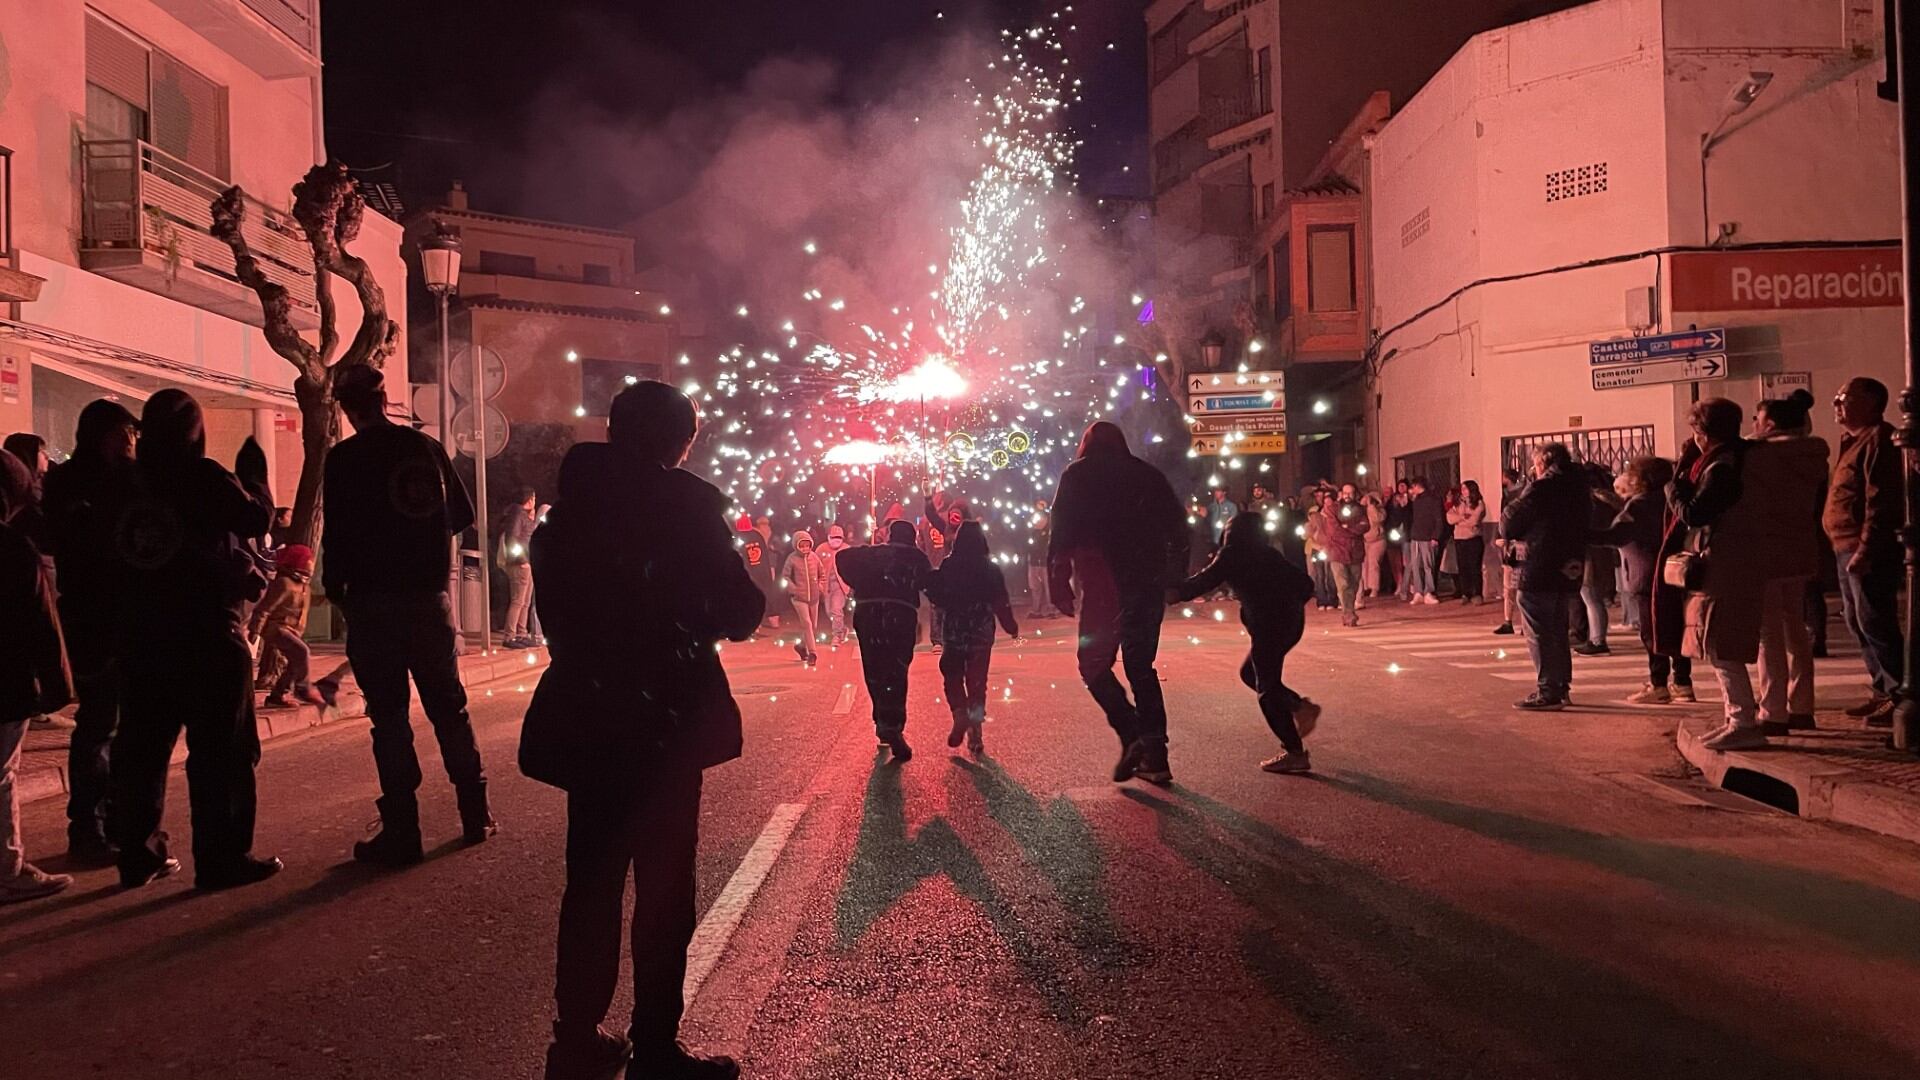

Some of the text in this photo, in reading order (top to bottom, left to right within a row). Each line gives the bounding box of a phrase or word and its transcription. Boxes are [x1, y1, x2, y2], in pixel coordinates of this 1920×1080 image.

[1732, 265, 1903, 306] Reparación
[1592, 341, 1638, 354] Castelló
[1593, 350, 1648, 363] Tarragona
[1595, 367, 1643, 379] cementeri
[1596, 378, 1634, 388] tanatori
